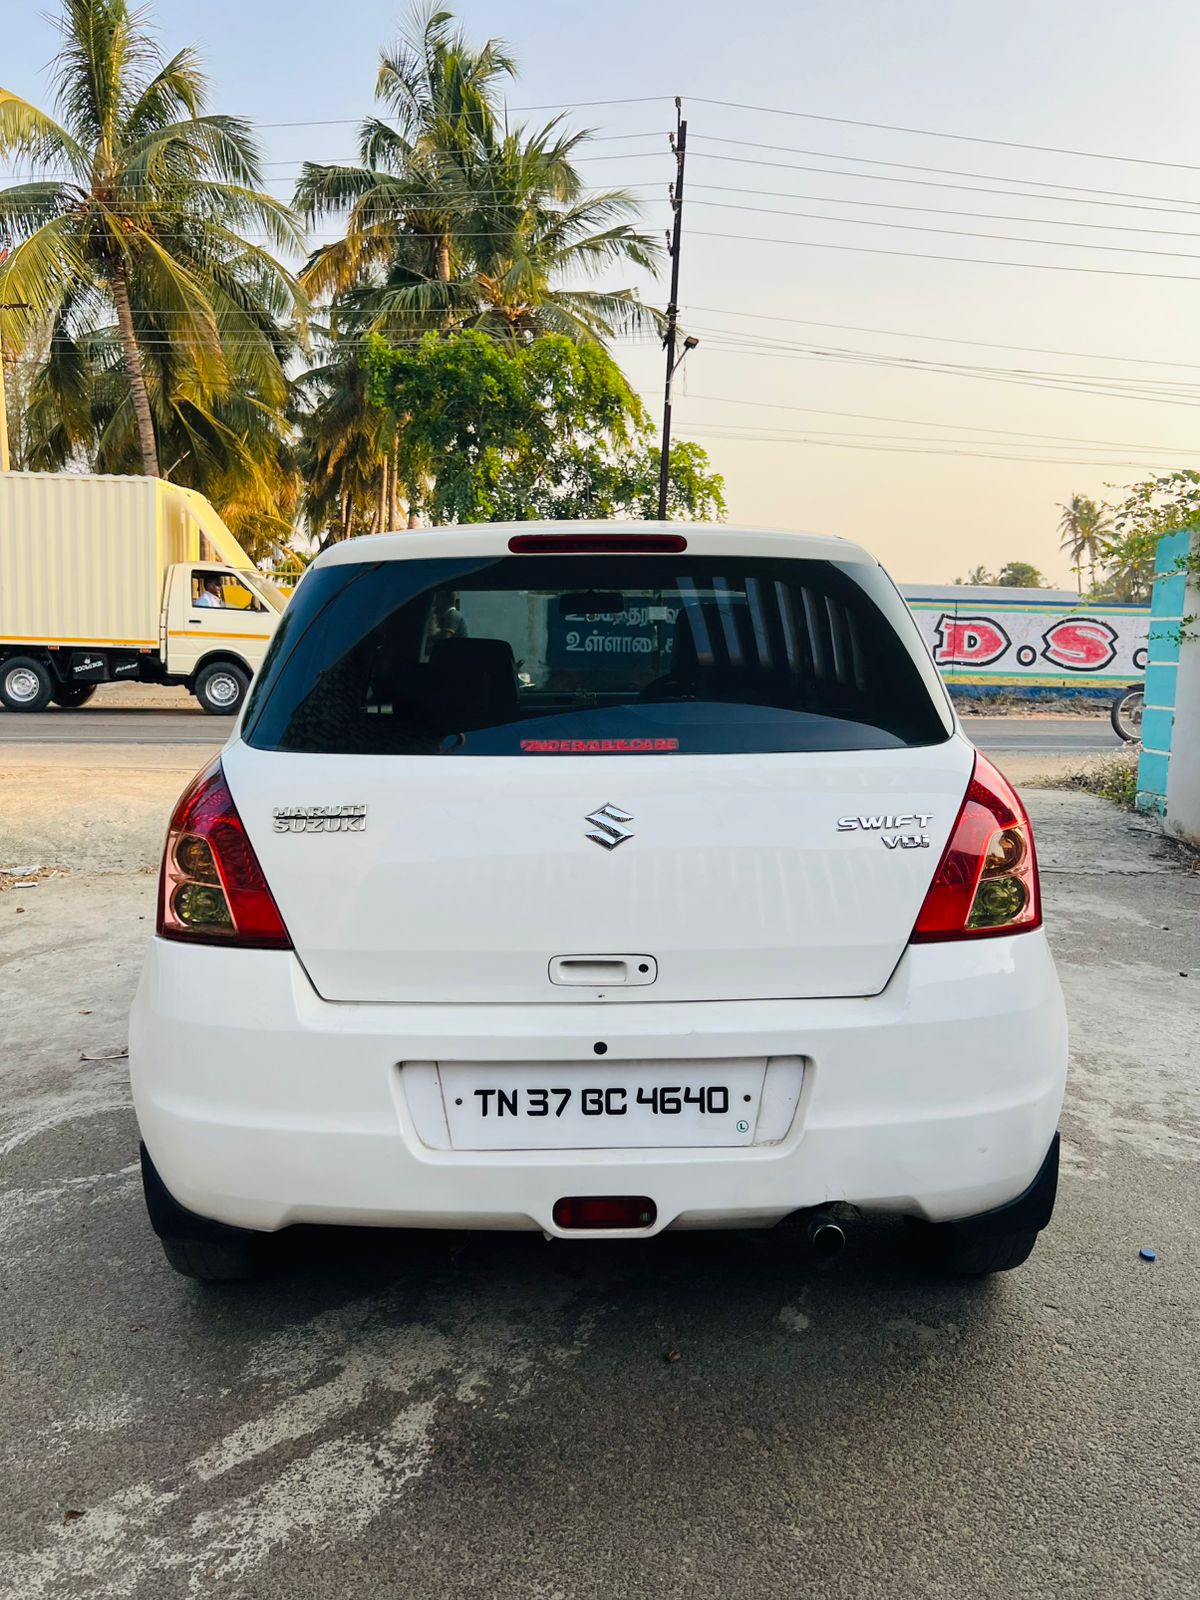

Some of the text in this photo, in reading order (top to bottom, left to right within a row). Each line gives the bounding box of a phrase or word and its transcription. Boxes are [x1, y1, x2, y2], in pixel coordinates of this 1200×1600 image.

[273, 805, 367, 818] MARUTI
[273, 817, 367, 833] SUZUKI
[837, 814, 934, 831] SWIFT
[881, 835, 930, 849] VDi
[474, 1086, 729, 1118] TN 37 BC 4640
